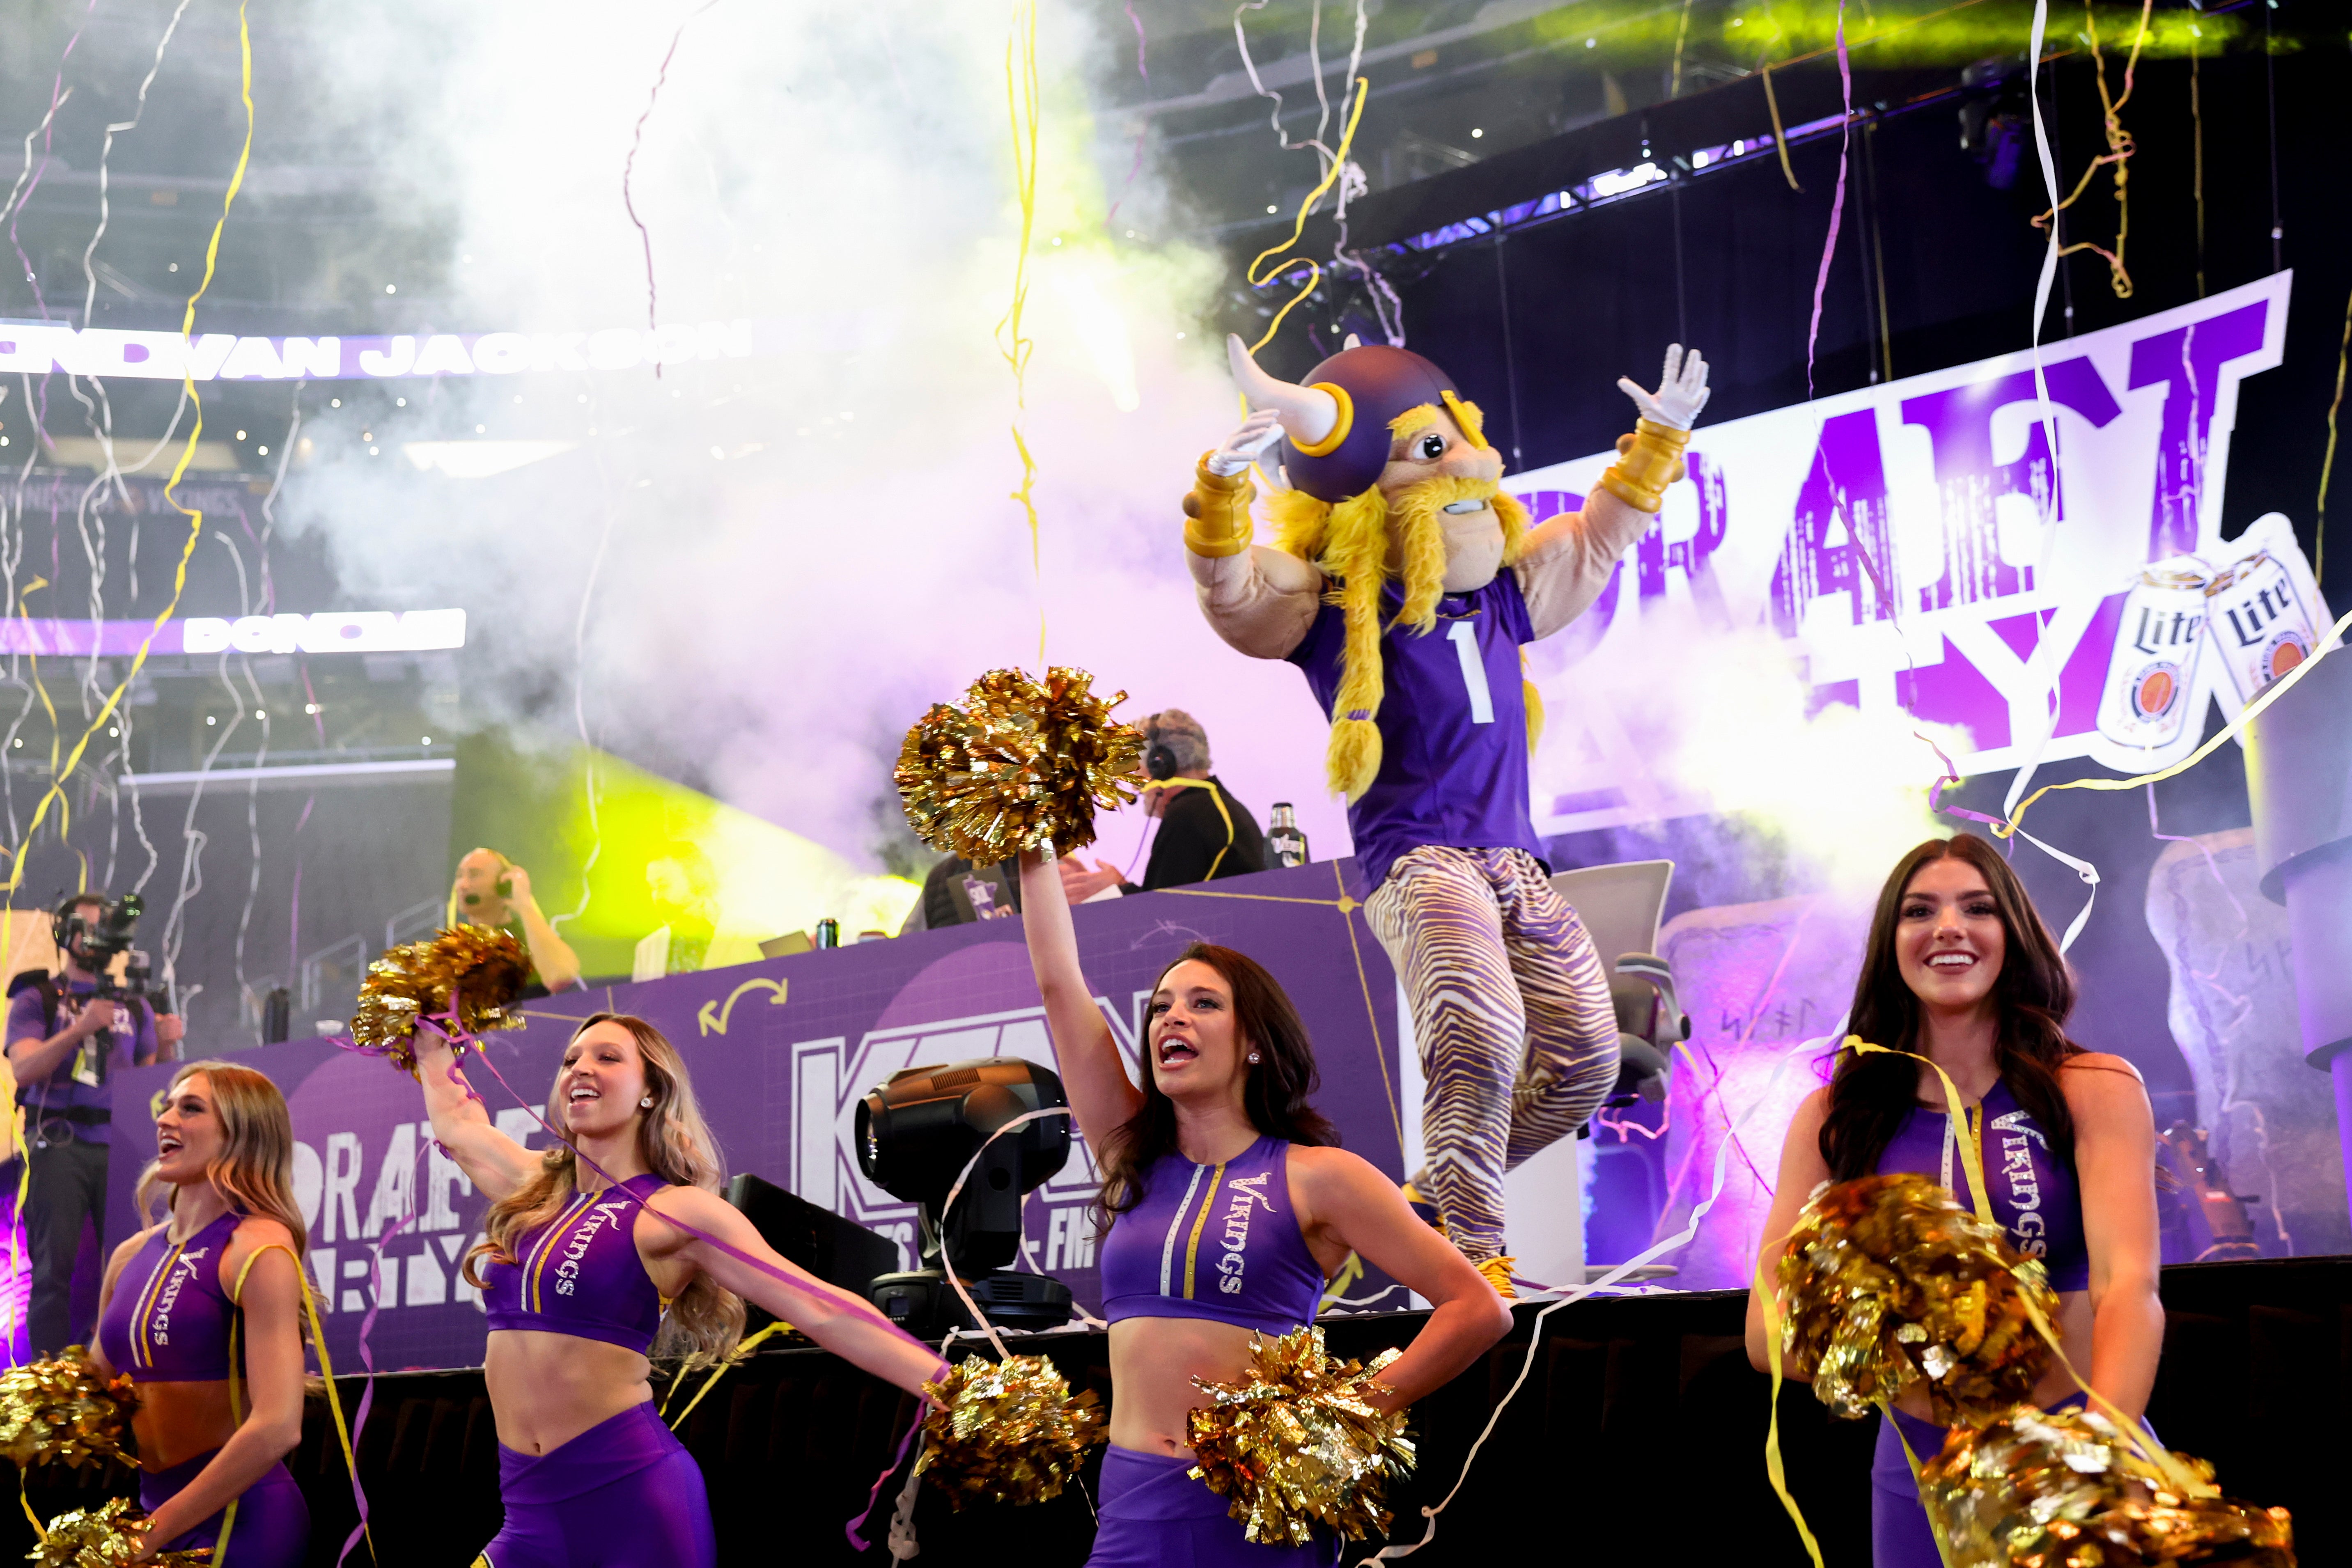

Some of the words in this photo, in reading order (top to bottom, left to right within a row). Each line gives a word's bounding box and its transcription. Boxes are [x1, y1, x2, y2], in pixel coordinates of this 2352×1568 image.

[2134, 607, 2201, 654] Lite
[2225, 578, 2290, 647] Lite
[1446, 621, 1495, 724] 1
